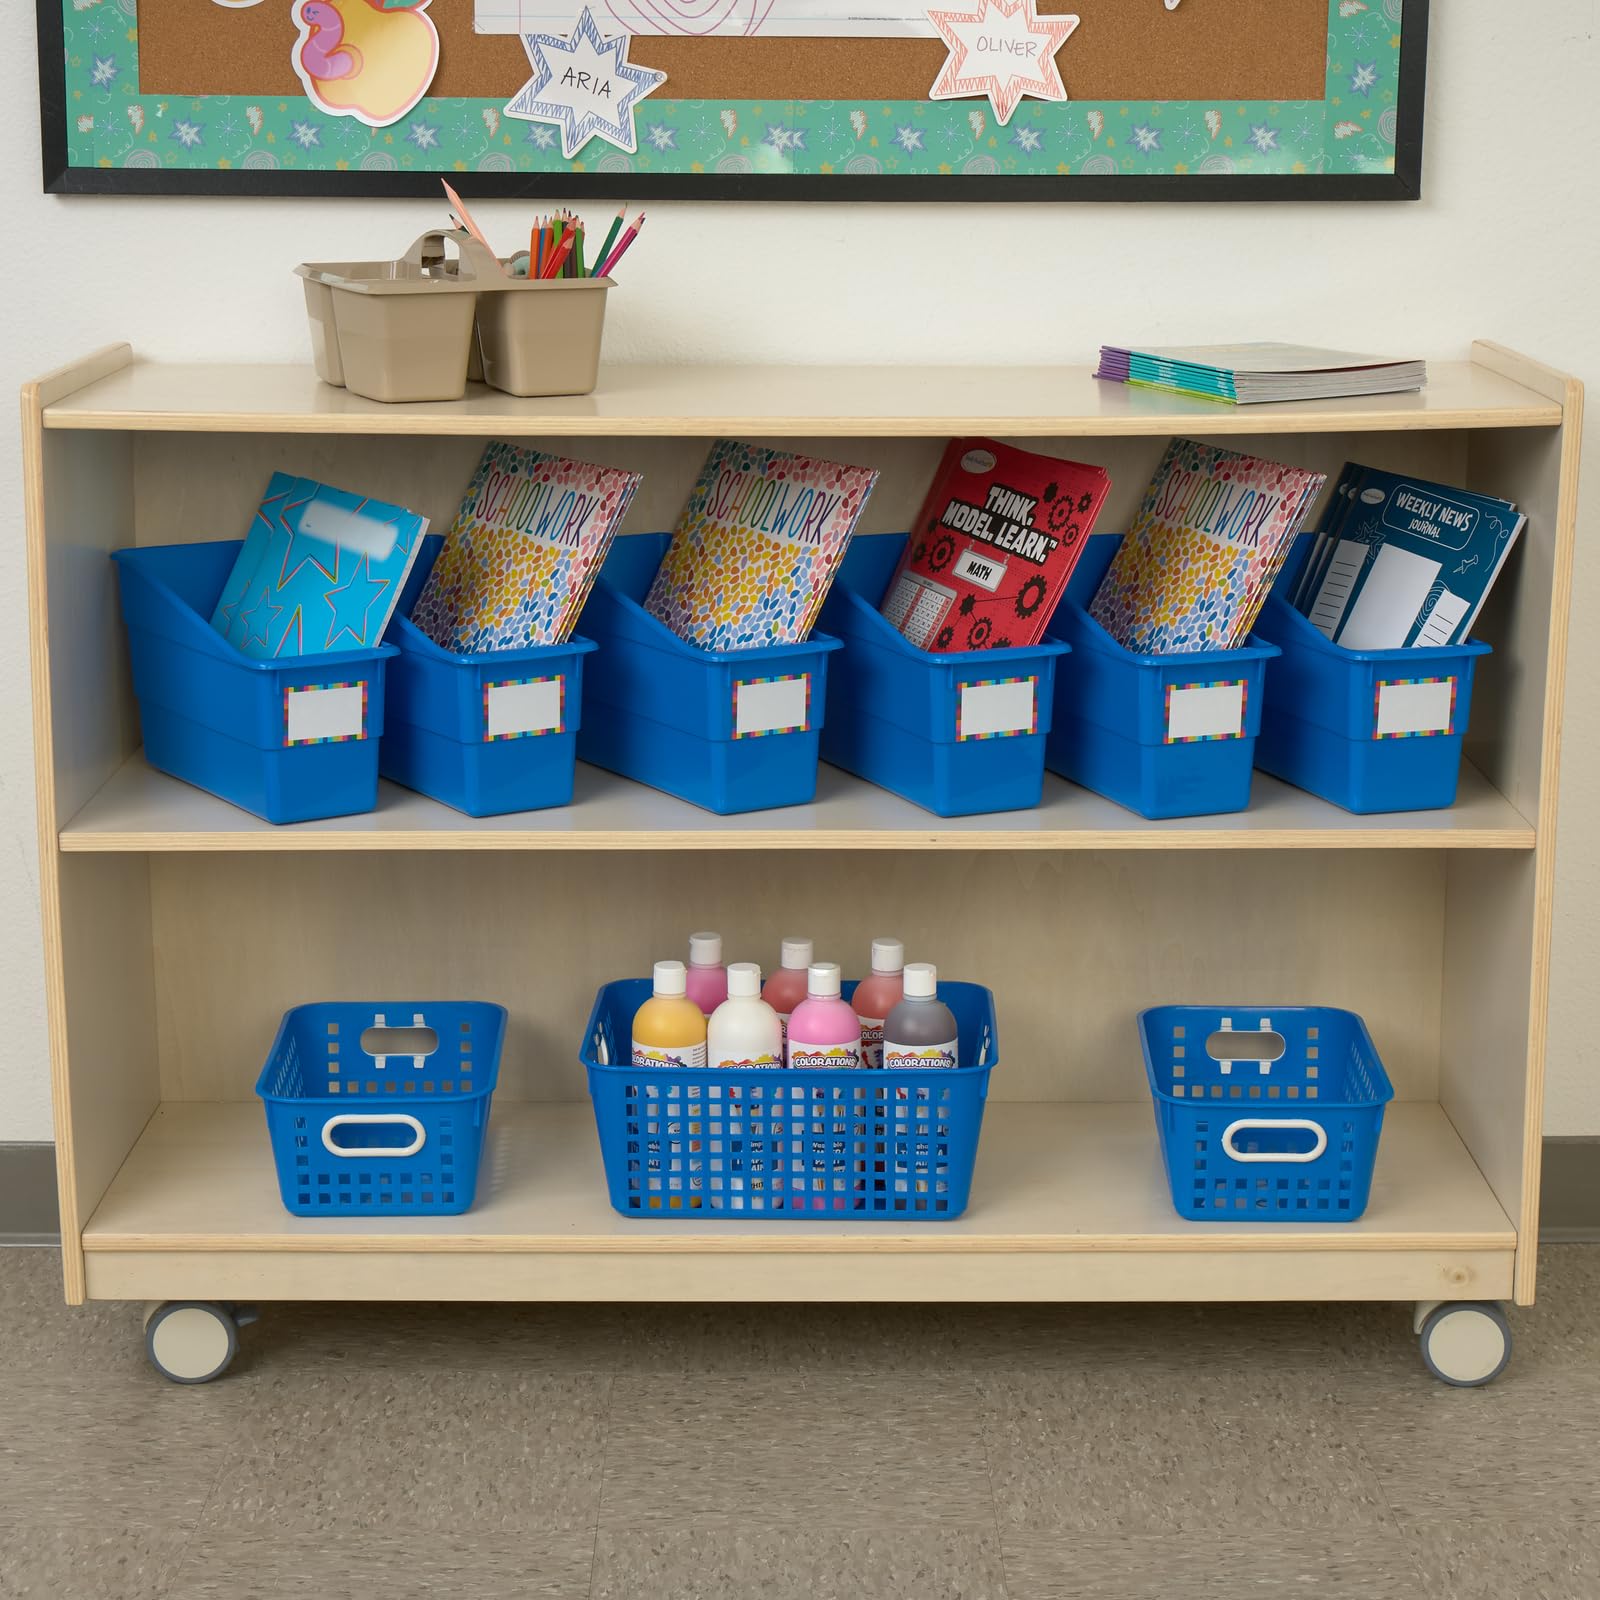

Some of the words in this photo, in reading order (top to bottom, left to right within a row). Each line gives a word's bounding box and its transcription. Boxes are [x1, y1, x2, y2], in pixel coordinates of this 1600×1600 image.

[976, 35, 1038, 58] OLIVER
[560, 66, 612, 99] ARIA
[476, 471, 600, 548] SCHOOLWORK
[706, 469, 841, 545] SCHOOLWORK
[941, 501, 994, 542] MODEL.
[984, 486, 1036, 526] THINK.
[1155, 469, 1280, 548] SCHOOLWORK
[1395, 491, 1438, 521] WEEKLY
[1437, 506, 1473, 532] NEWS
[1407, 518, 1440, 538] JOURNAL
[966, 561, 993, 581] MATH
[795, 1056, 857, 1068] COLORATIONS
[888, 1056, 951, 1068] COLORATIONS
